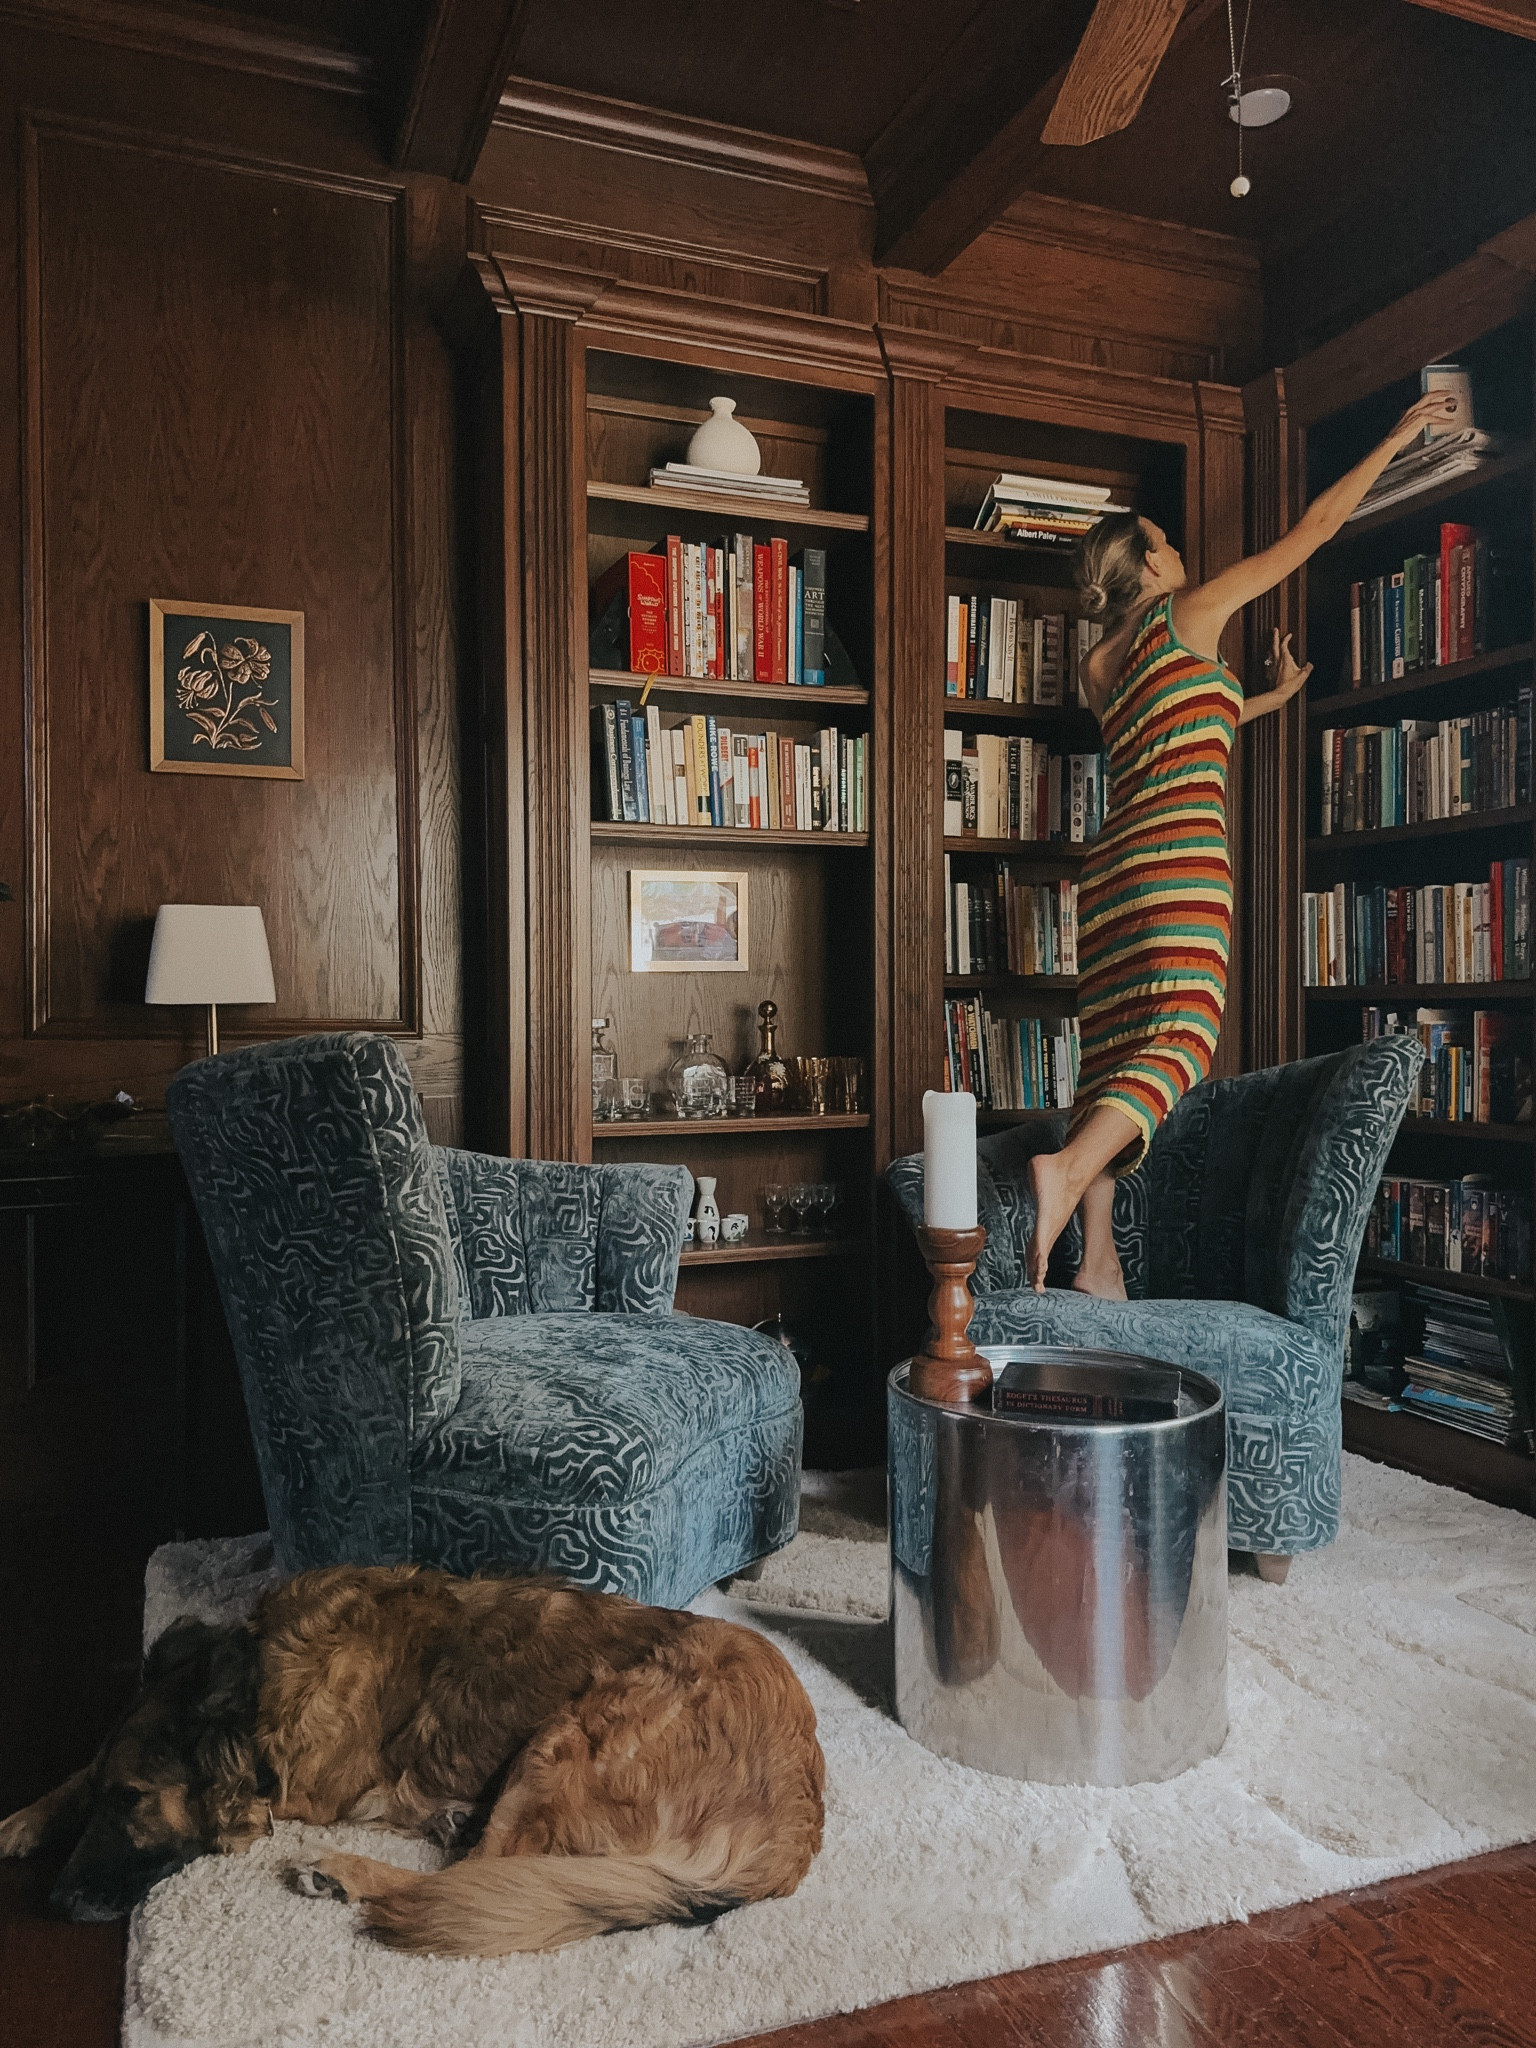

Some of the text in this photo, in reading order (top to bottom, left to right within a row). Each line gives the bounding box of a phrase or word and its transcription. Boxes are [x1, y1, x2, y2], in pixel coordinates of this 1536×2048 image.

[1016, 528, 1037, 539] Albert
[1038, 530, 1057, 542] Paley
[804, 590, 825, 600] ART
[1459, 566, 1468, 629] CRYPTOGRAPHY
[1008, 617, 1016, 634] How
[1005, 642, 1014, 655] Say
[1009, 634, 1016, 642] to
[619, 719, 630, 753] Fundamentals
[697, 718, 706, 758] FOUNDERS
[708, 719, 718, 772] MIKE ROWE
[720, 735, 729, 762] DILBERT
[622, 759, 632, 780] Business
[1520, 868, 1528, 896] William
[967, 1013, 978, 1050] WATCHMEN
[1005, 1391, 1088, 1404] ROGET'S THESAURUS
[1014, 1401, 1062, 1411] DICTIONARY
[1065, 1405, 1088, 1413] FORM
